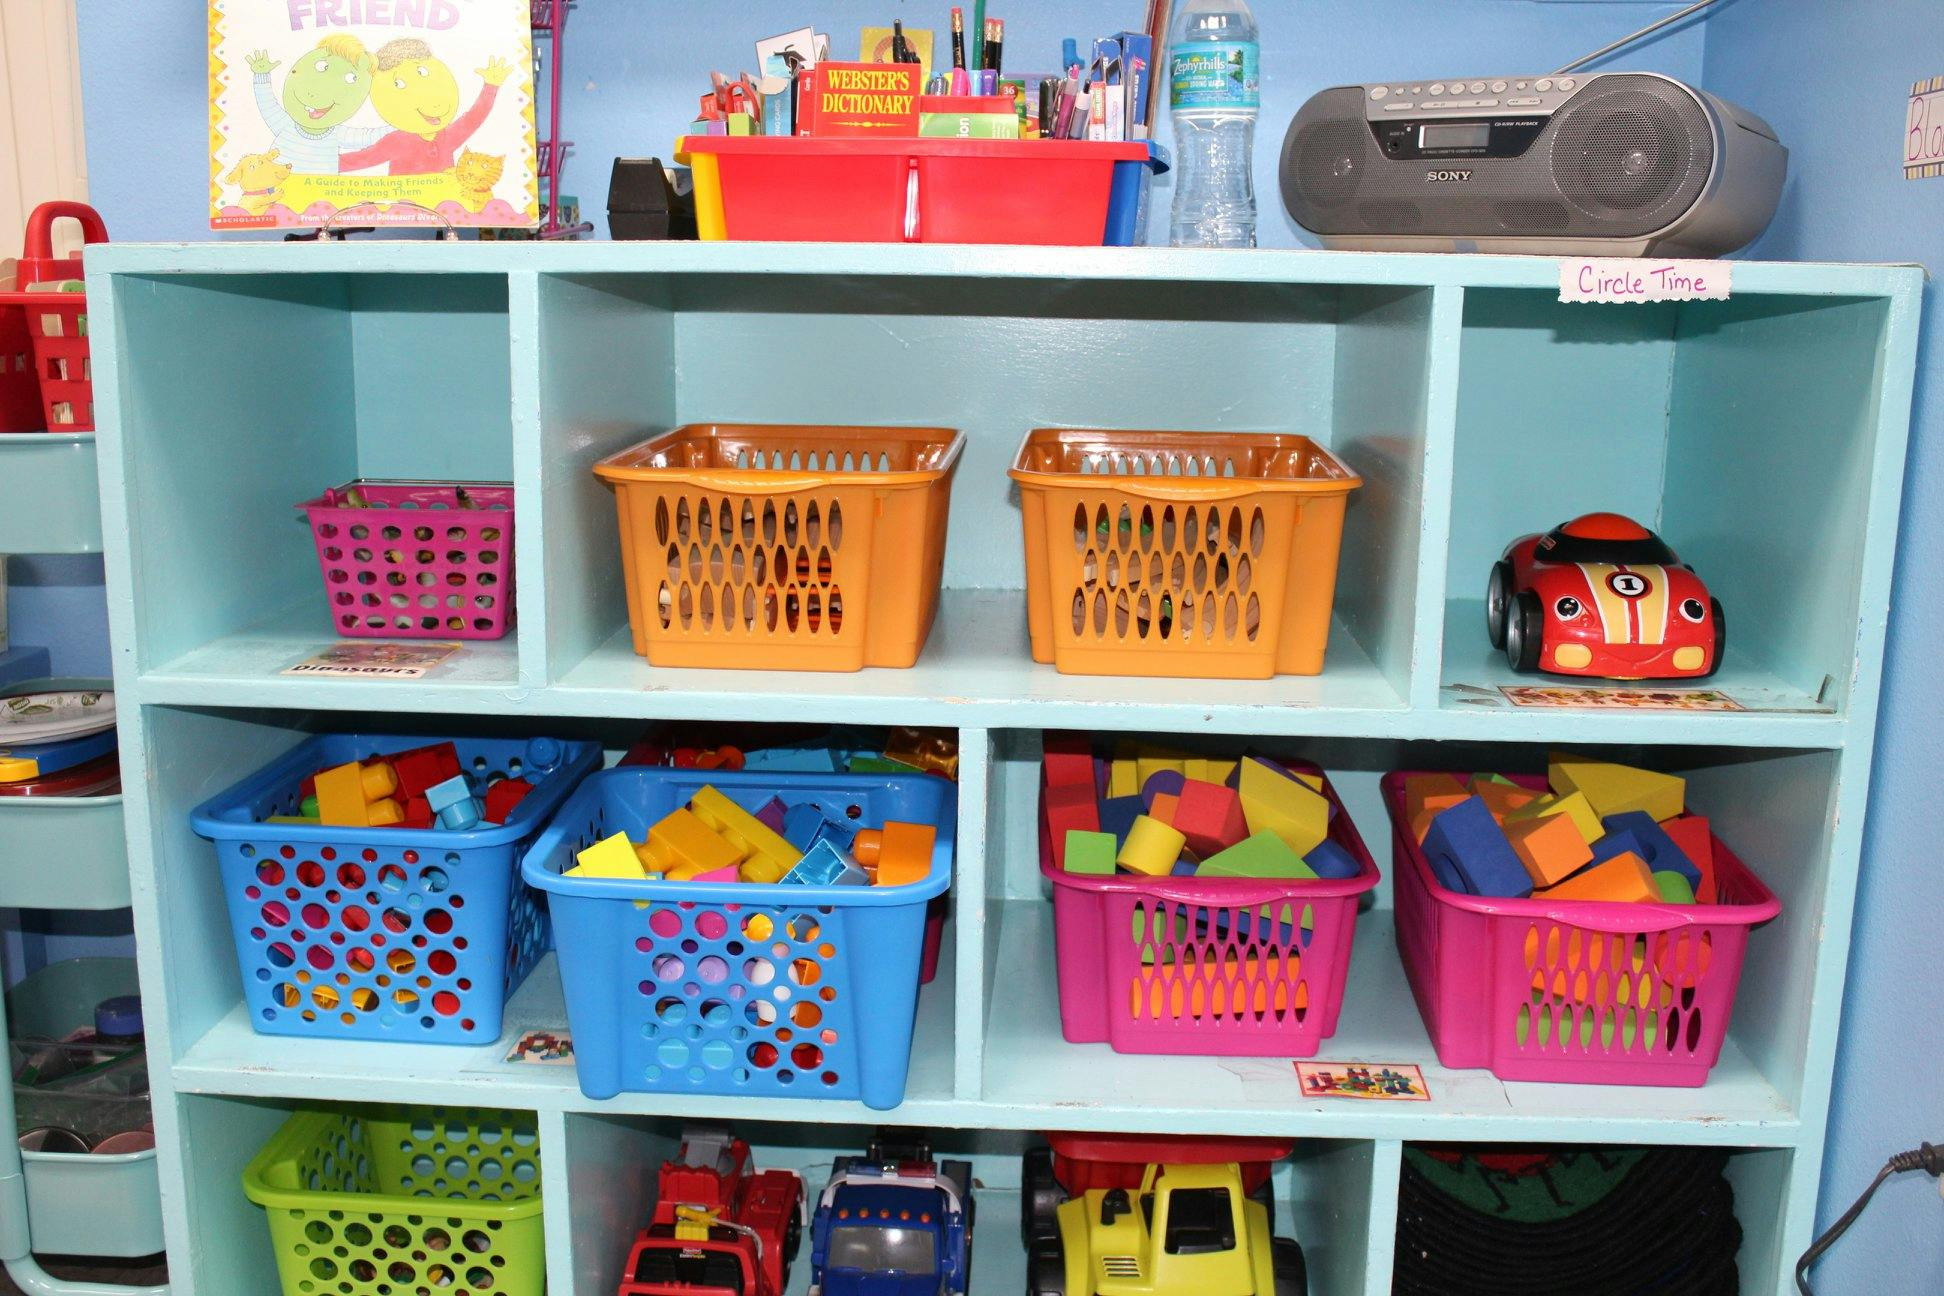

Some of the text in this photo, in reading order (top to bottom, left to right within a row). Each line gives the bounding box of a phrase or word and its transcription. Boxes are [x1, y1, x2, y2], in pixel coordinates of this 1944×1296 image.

[287, 0, 460, 31] FRIEND
[1173, 56, 1226, 76] Zephyrhills
[828, 69, 910, 91] WEBSTER'S
[1002, 86, 1015, 95] 36
[822, 93, 914, 115] DICTIONARY
[304, 176, 444, 189] A Guide to Making Friends
[1426, 171, 1471, 182] SONY
[324, 187, 423, 199] and Keeping Them
[1578, 265, 1707, 295] Circle Time
[1620, 578, 1638, 590] 1
[292, 664, 419, 675] Dinosaurs
